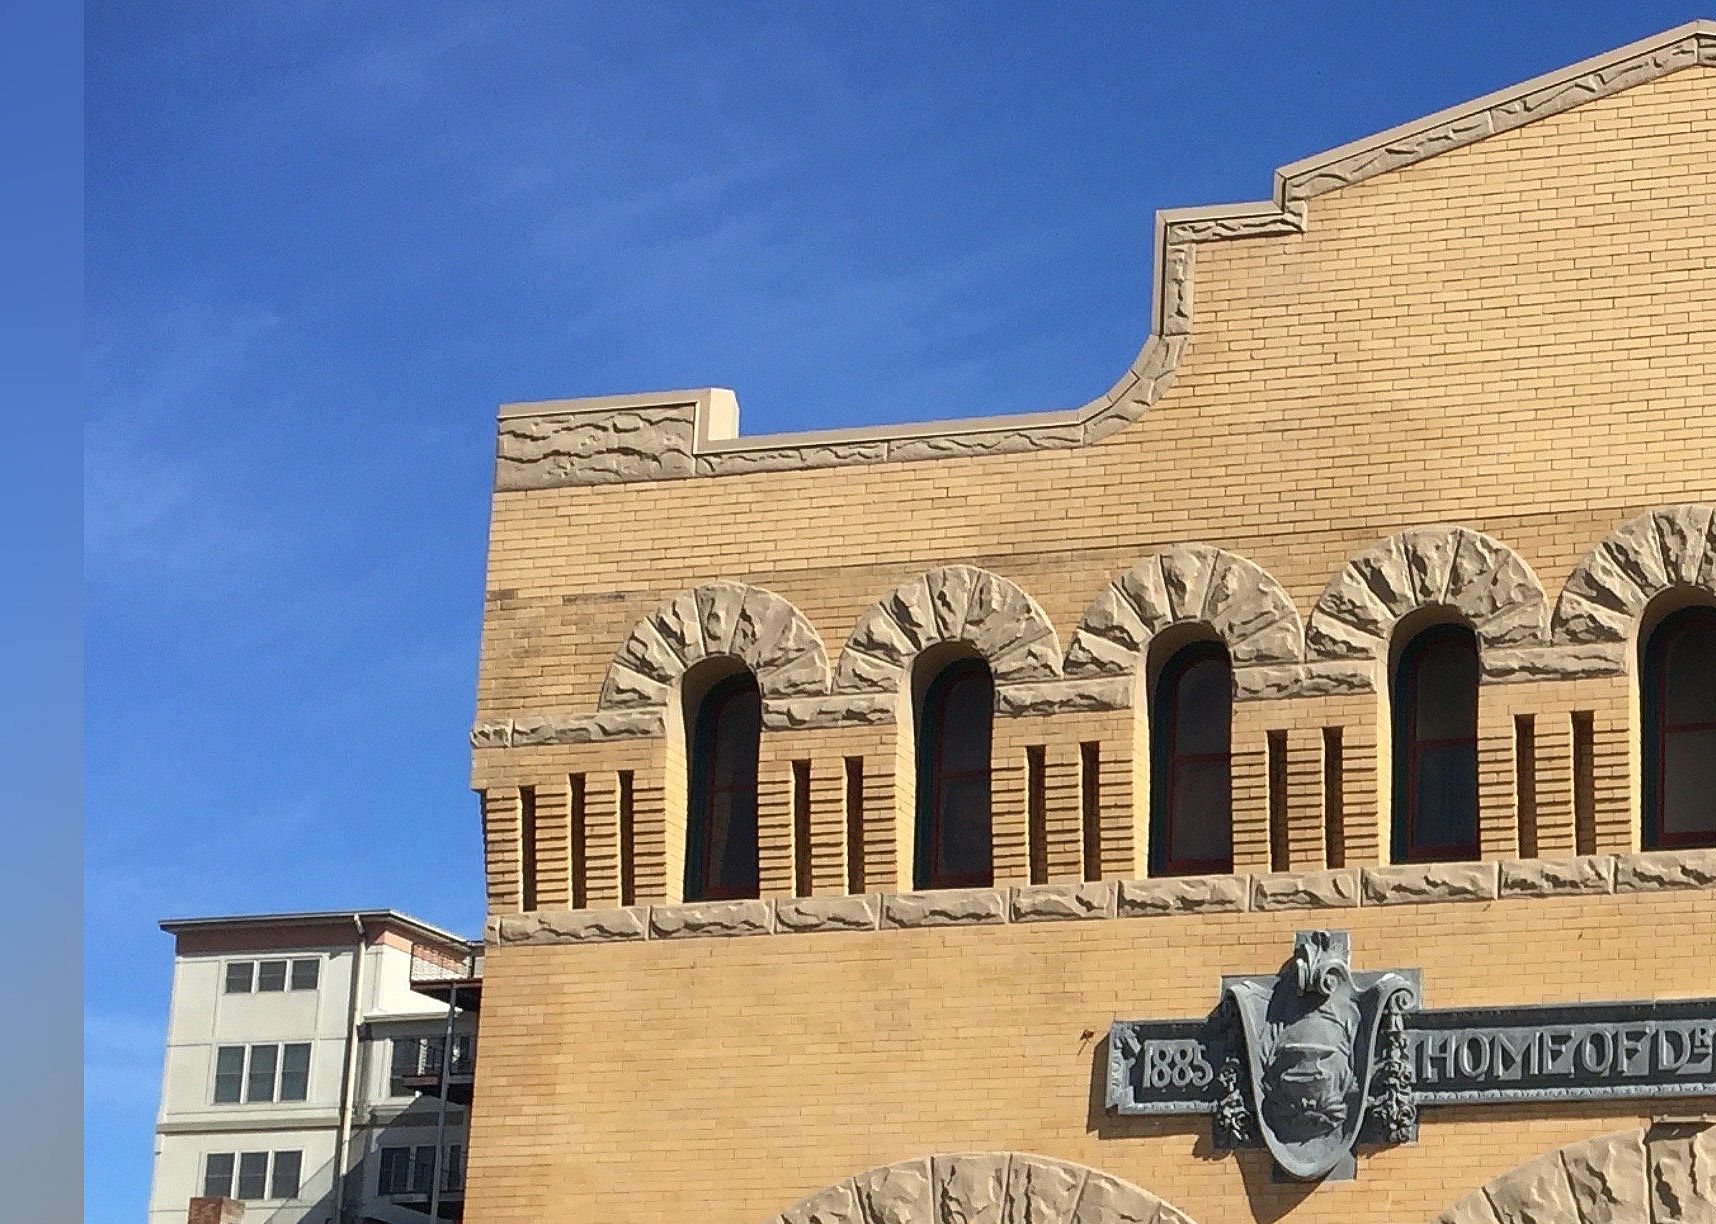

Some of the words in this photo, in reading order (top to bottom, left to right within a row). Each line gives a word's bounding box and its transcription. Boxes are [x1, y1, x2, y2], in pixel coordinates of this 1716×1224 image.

[1143, 1039, 1214, 1088] 1885
[1421, 1029, 1576, 1080] HOME
[1580, 1026, 1653, 1076] OF
